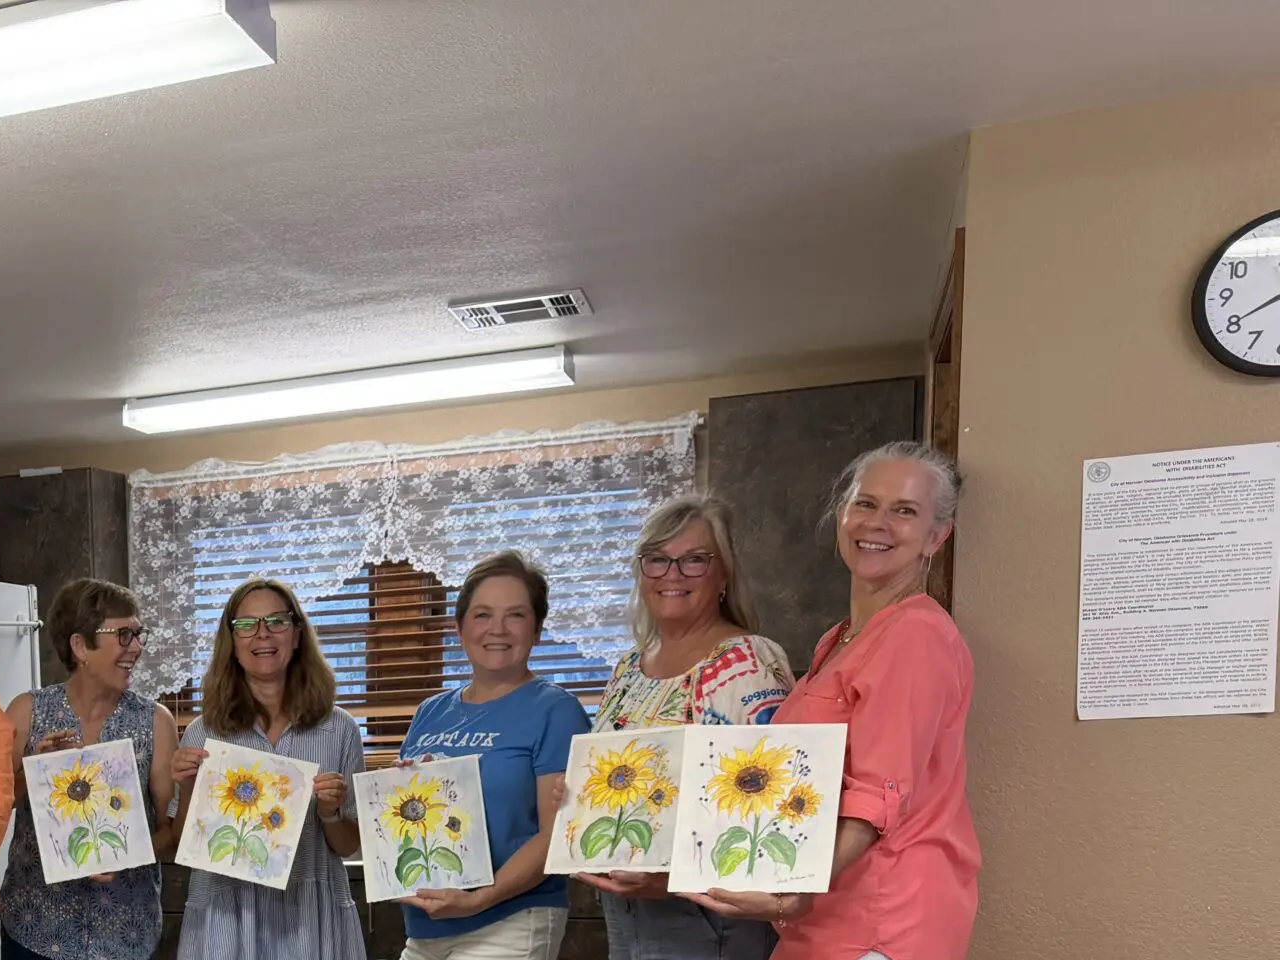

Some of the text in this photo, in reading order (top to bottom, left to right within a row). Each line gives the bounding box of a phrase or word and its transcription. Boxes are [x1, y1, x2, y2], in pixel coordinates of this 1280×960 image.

[1228, 261, 1248, 280] 10
[1219, 288, 1234, 307] 9
[1226, 315, 1241, 333] 8
[1248, 330, 1264, 350] 7
